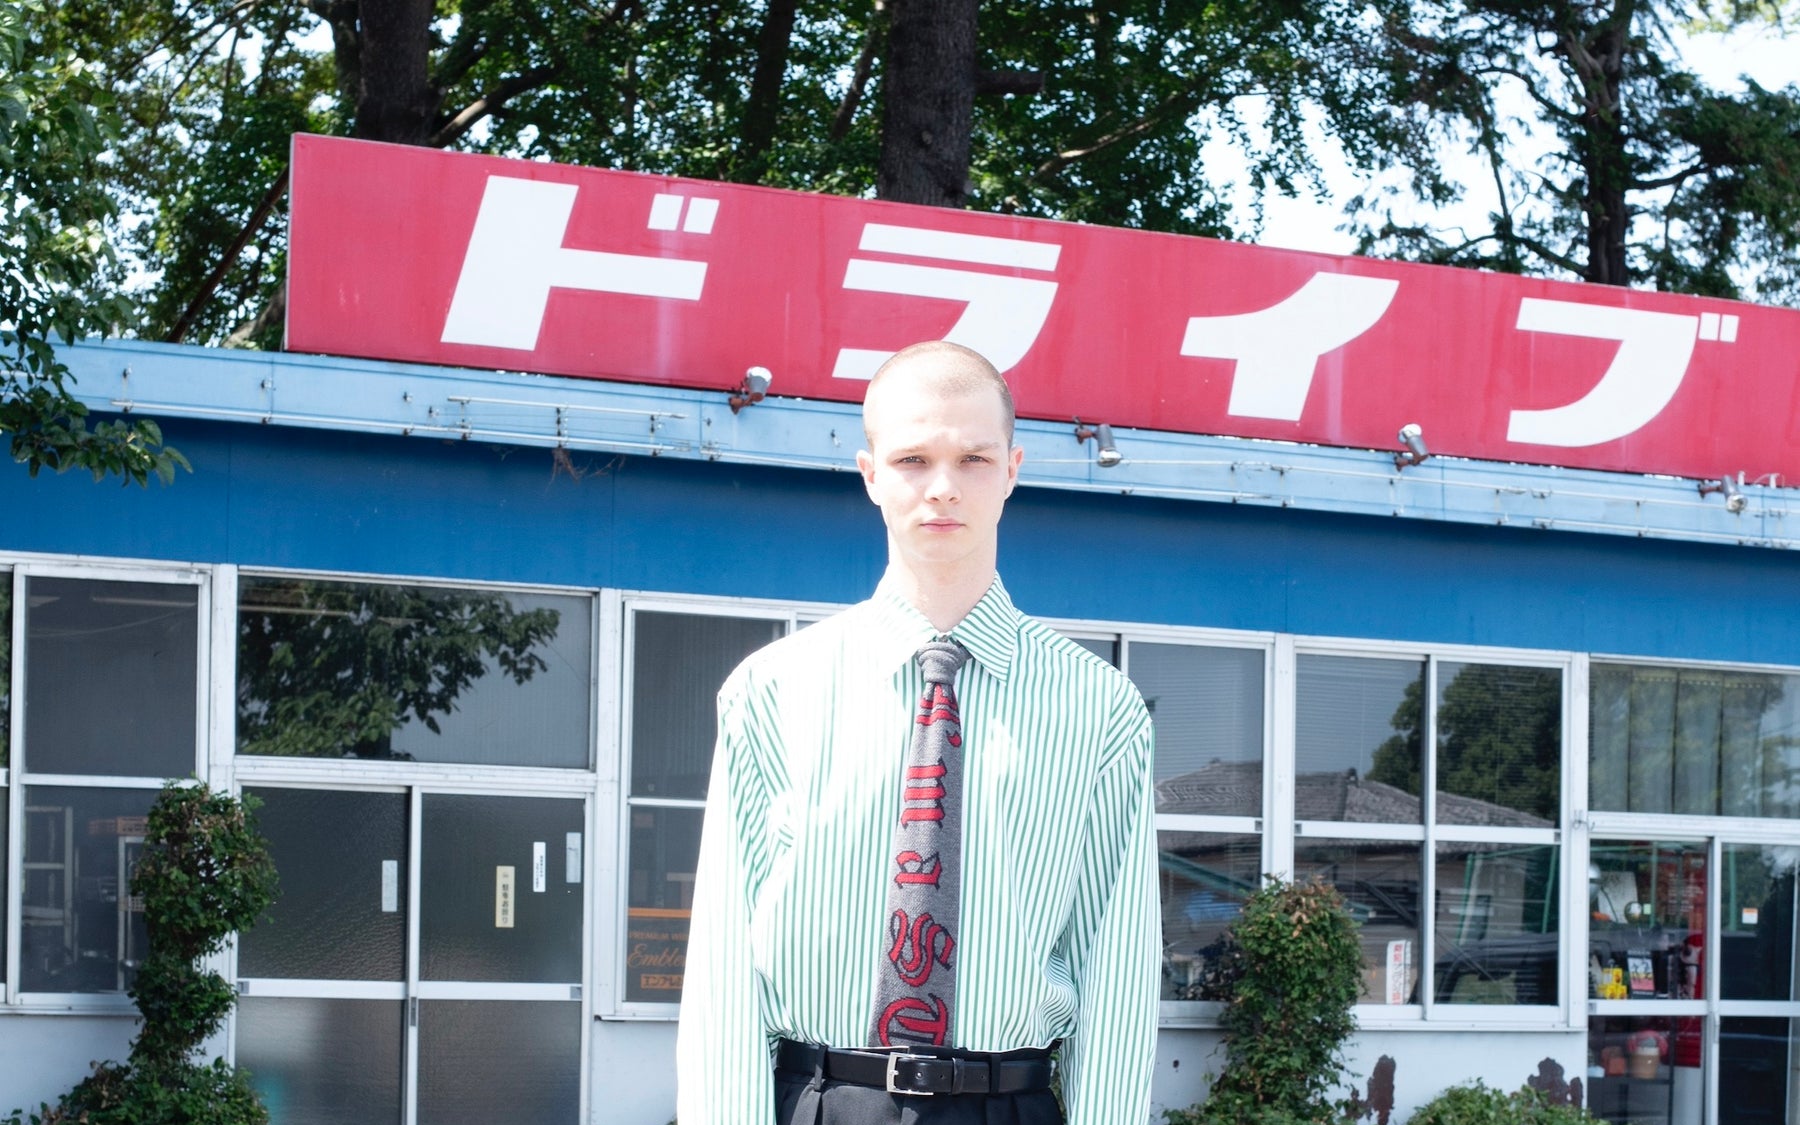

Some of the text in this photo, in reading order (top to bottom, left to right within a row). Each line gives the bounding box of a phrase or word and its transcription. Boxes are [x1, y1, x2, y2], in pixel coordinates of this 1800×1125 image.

[440, 175, 1739, 447] ドライブ
[627, 943, 686, 968] Emble
